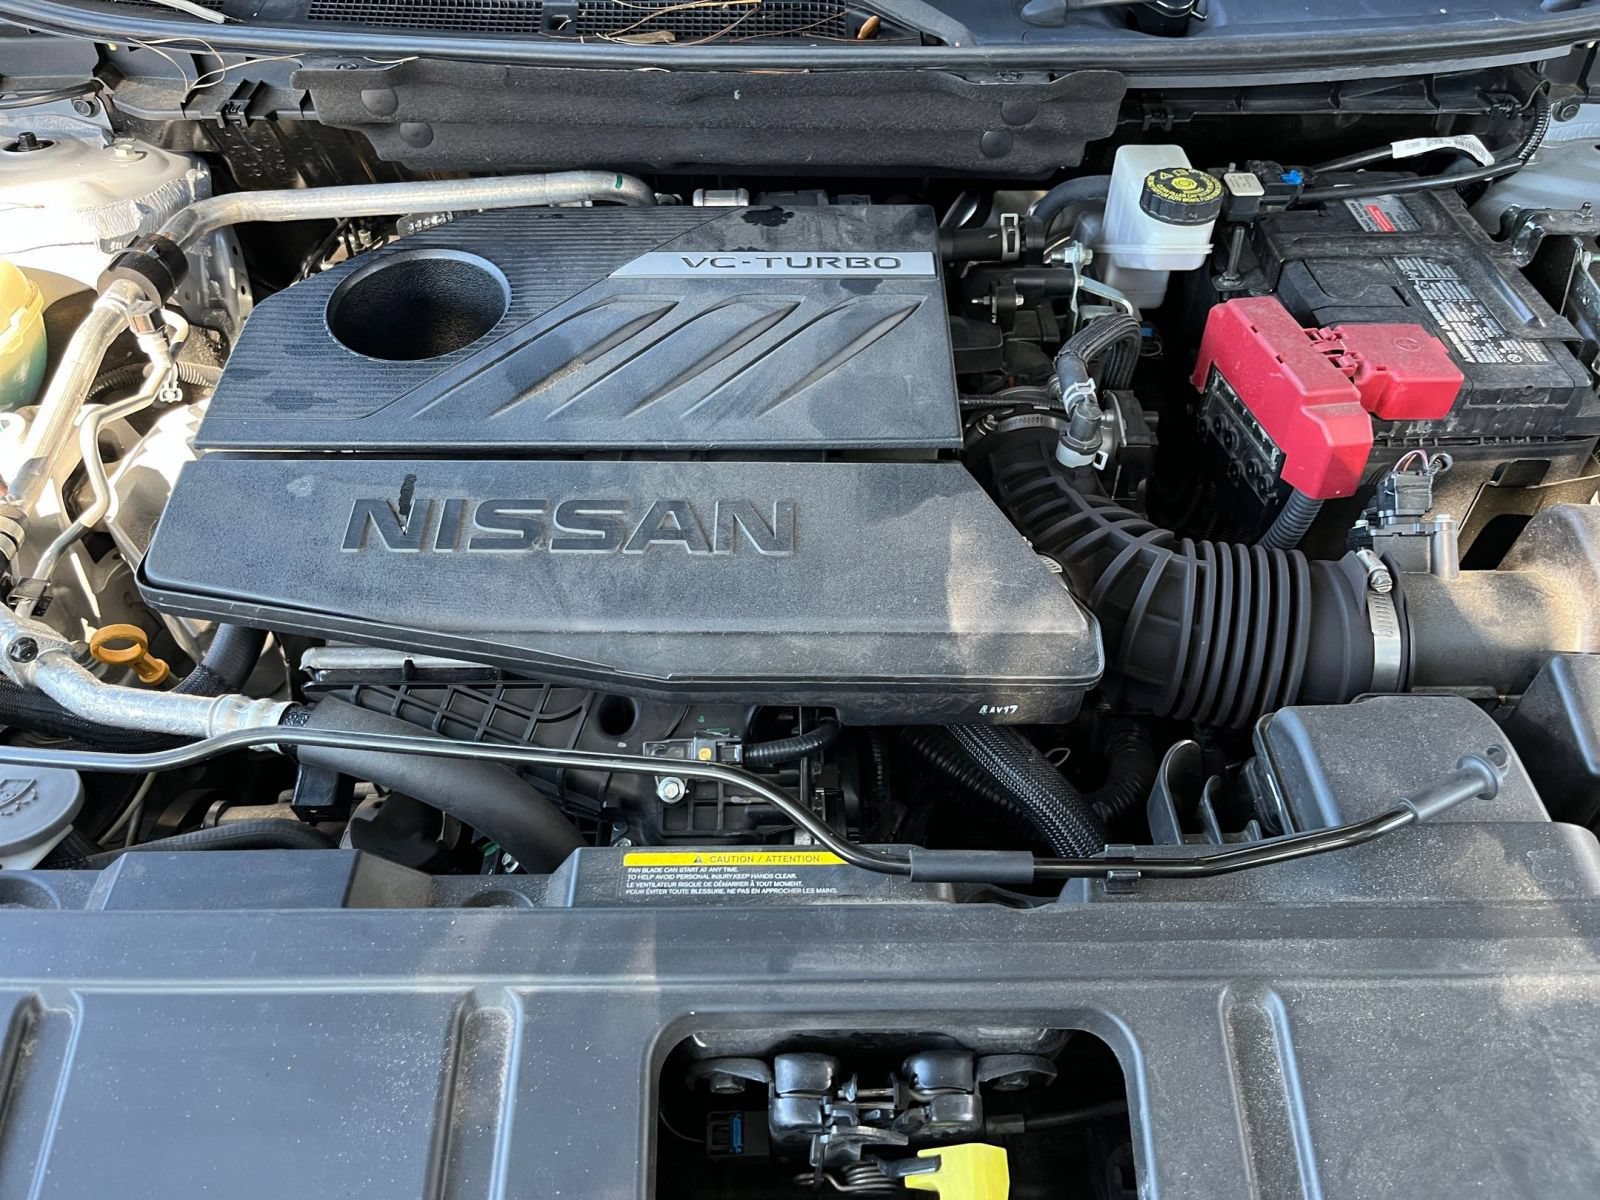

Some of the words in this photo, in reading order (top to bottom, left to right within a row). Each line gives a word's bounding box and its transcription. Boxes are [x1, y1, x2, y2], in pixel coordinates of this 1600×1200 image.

[680, 256, 901, 269] VC-TURBO
[340, 499, 795, 555] NISSAN
[709, 855, 754, 864] CAUTION
[766, 855, 820, 863] ATTENTION
